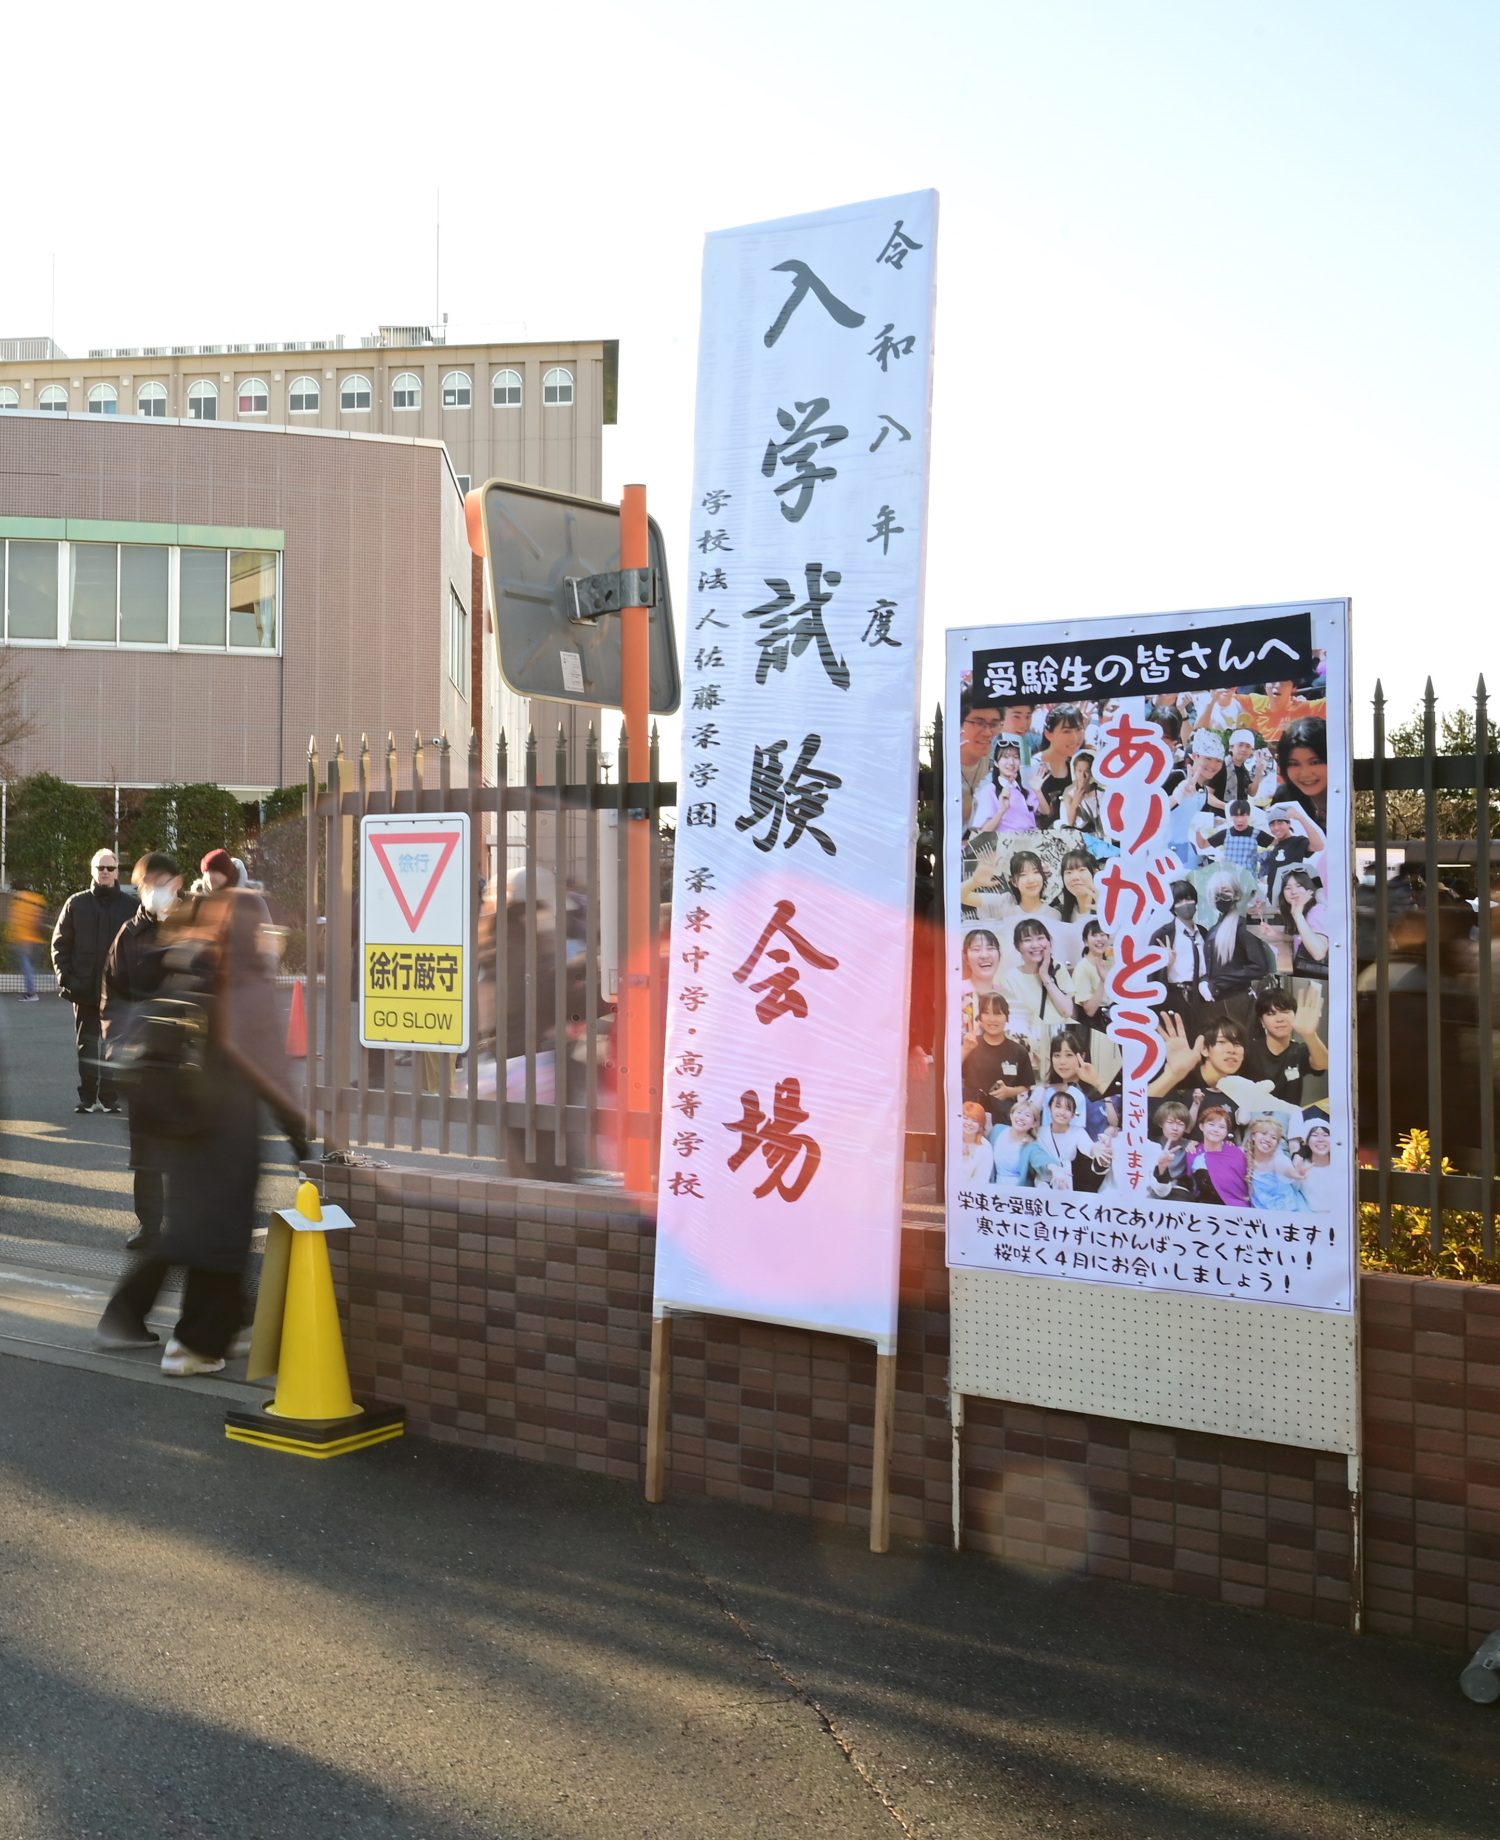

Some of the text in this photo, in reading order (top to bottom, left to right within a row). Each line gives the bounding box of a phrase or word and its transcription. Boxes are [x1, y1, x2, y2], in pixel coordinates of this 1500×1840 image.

[861, 220, 923, 647] 令和八年度
[983, 638, 1300, 699] 受験生の皆さんへ
[722, 259, 866, 1202] 入学試験会場
[369, 951, 459, 992] 徐行厳守
[373, 1010, 453, 1030] GO SLOW
